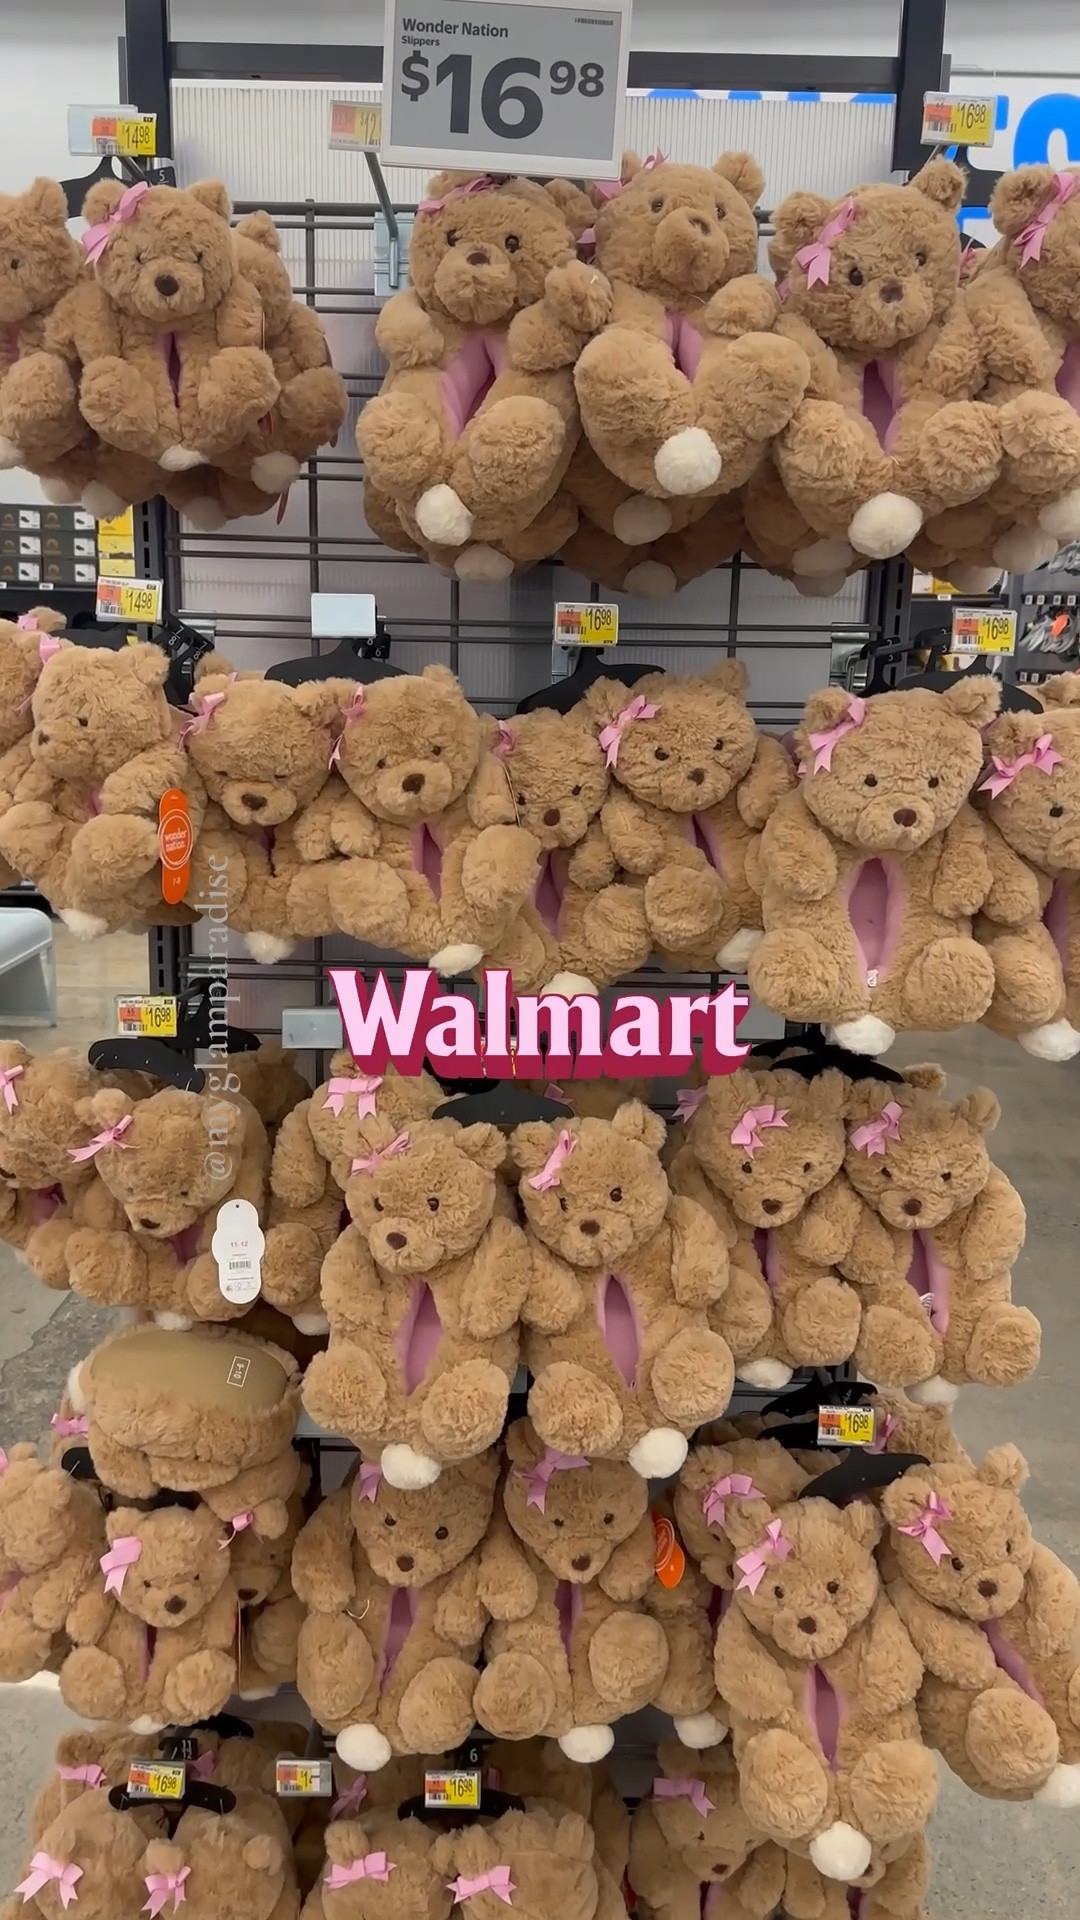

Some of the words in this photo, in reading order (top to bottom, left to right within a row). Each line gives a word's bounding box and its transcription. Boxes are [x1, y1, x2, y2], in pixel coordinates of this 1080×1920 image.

[402, 18, 459, 35] Wonder
[461, 21, 509, 38] Nation
[401, 35, 440, 47] Slippers
[469, 1748, 479, 1763] 6
